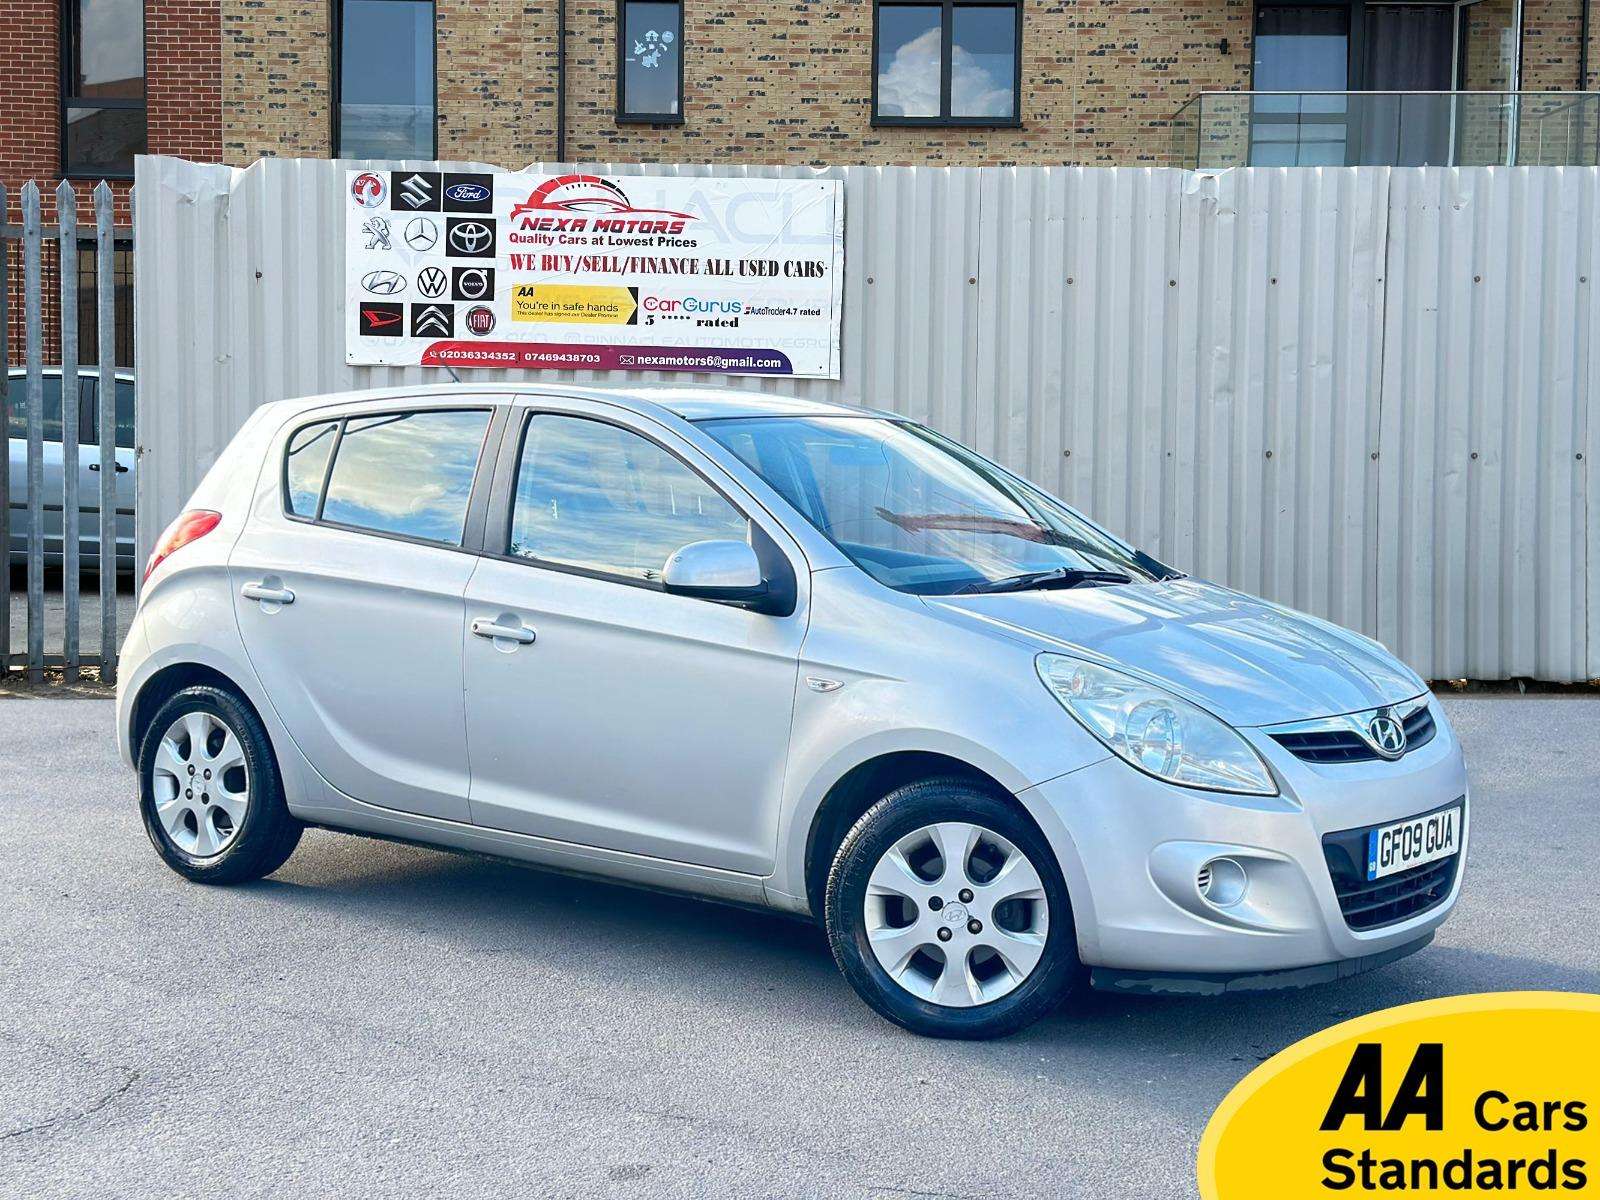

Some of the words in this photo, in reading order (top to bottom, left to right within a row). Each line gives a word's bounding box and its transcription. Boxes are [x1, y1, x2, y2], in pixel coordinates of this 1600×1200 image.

[454, 186, 481, 199] Ford
[520, 217, 588, 232] NEXA
[592, 219, 686, 235] MOTORS
[509, 232, 555, 246] Quality
[558, 234, 588, 245] Cars
[591, 235, 604, 246] at
[608, 236, 654, 247] Lowest
[657, 237, 697, 248] Prices
[509, 254, 536, 271] WE
[704, 258, 734, 276] ALL
[739, 259, 780, 277] USED
[517, 287, 534, 297] AA
[517, 300, 549, 310] You're
[552, 302, 561, 310] in
[563, 302, 585, 311] safe
[587, 302, 619, 312] hands
[643, 296, 742, 313] CarGurus
[800, 308, 821, 316] rated
[473, 314, 489, 328] FIAT
[645, 315, 654, 325] 5
[696, 317, 739, 328] rated
[440, 351, 516, 361] 02036334352
[525, 352, 600, 363] 07469438703
[637, 355, 781, 369] nexamotors6@gmail.com
[1381, 823, 1423, 867] GF09
[1426, 813, 1452, 853] GUA
